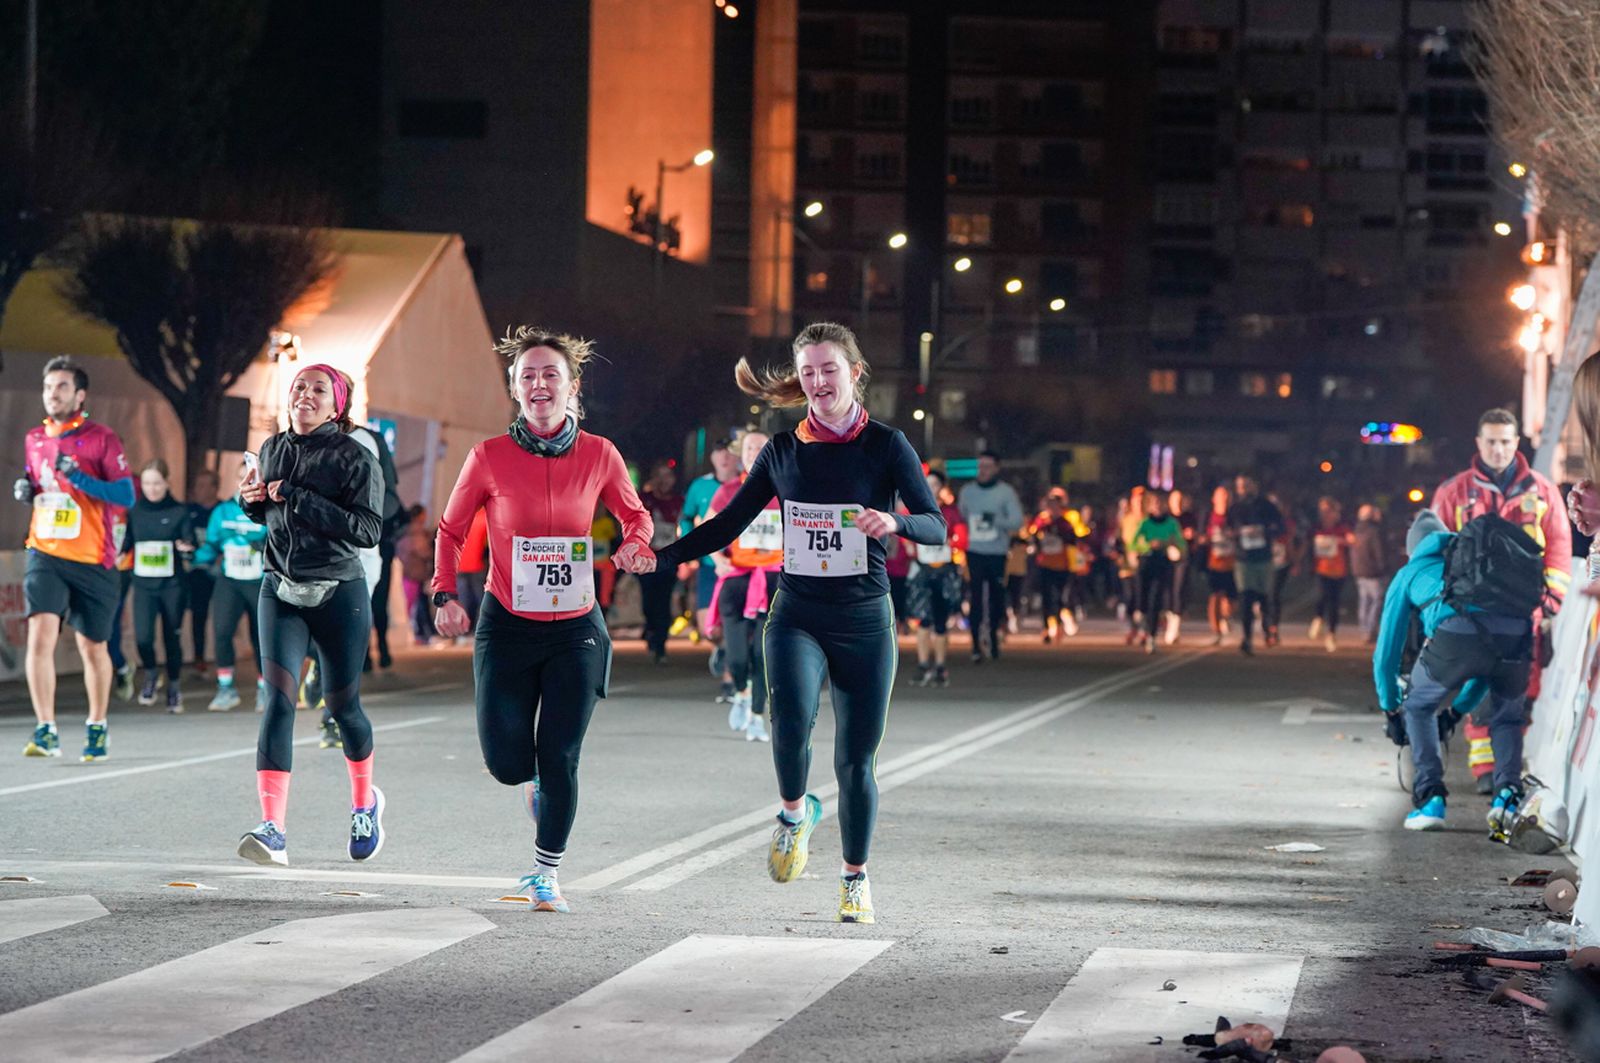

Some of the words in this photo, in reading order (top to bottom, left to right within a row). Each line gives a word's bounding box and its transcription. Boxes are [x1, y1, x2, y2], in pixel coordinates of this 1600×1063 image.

[792, 519, 806, 527] SAN
[806, 530, 842, 551] 754
[522, 554, 538, 562] SAN
[536, 563, 572, 586] 753
